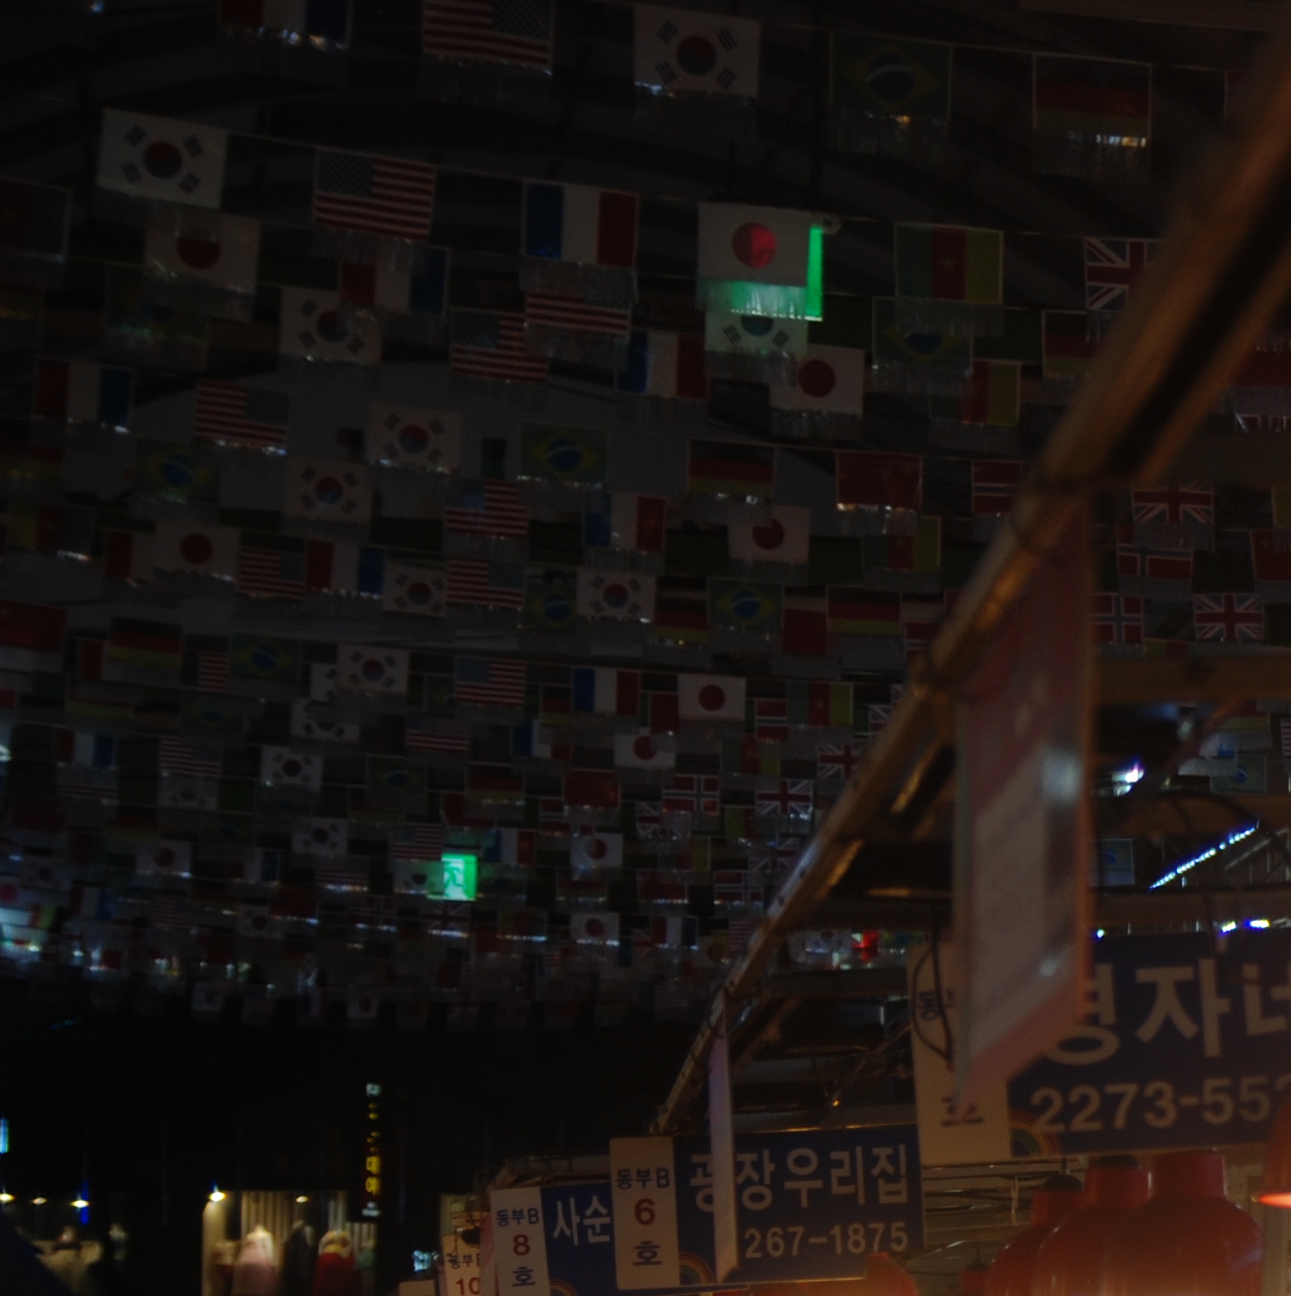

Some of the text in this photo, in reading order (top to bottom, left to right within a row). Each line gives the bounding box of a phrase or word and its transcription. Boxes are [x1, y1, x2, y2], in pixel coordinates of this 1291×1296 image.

[615, 1167, 671, 1191] 동부B
[495, 1207, 540, 1228] 동부B
[633, 1197, 656, 1226] 6
[512, 1233, 531, 1257] 8
[632, 1240, 663, 1267] 호
[511, 1265, 537, 1288] 호
